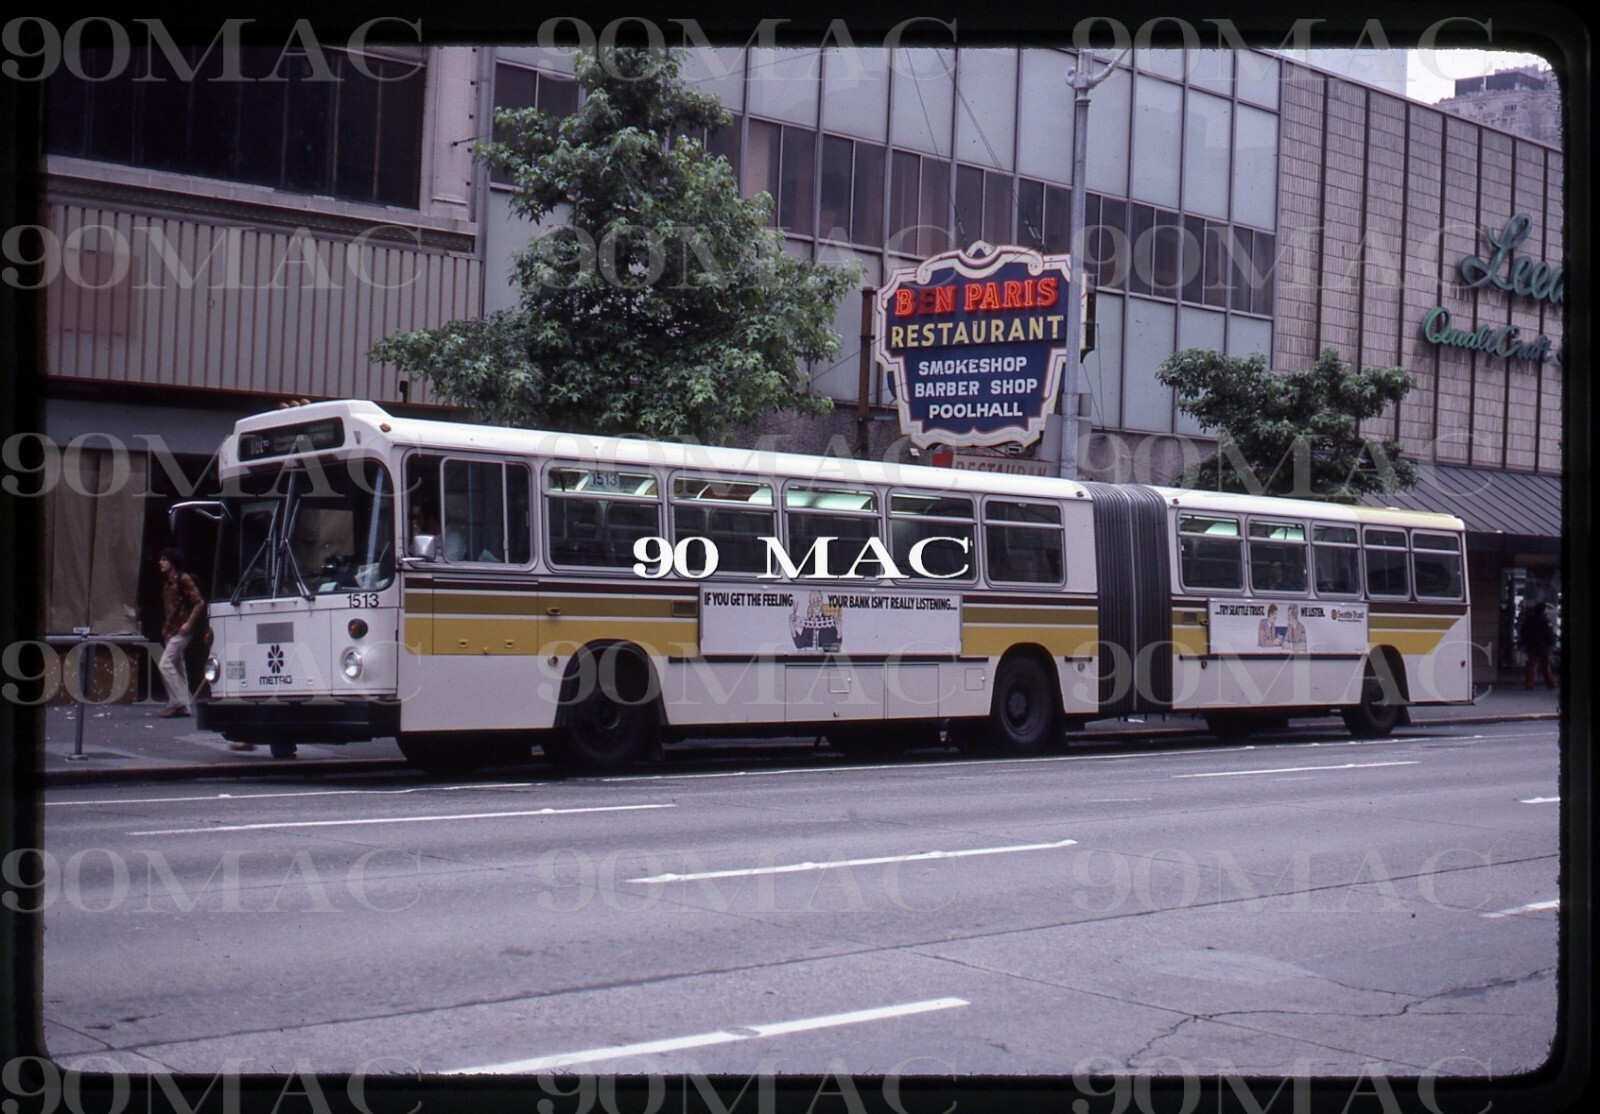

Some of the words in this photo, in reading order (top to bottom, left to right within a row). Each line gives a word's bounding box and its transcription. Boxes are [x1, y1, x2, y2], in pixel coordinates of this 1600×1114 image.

[895, 286, 956, 316] BEN
[964, 278, 1058, 311] PARIS
[891, 315, 1064, 348] RESTAURANT
[918, 356, 1028, 375] SMOKESHOP
[914, 381, 980, 397] BARBER
[990, 378, 1038, 395] SHOP
[929, 402, 1023, 419] POOLHALL
[593, 472, 618, 486] 1513
[347, 593, 380, 608] 1513
[704, 592, 711, 606] IF
[713, 592, 730, 606] YOU
[731, 593, 745, 606] GET
[747, 593, 761, 607] THE
[763, 593, 793, 607] FEELING
[828, 594, 848, 608] YOUR
[850, 595, 870, 609] BANK
[871, 596, 889, 609] ISN'T
[891, 597, 914, 610] REALLY
[1229, 605, 1248, 616] SEATTLE
[259, 675, 292, 685] METRO
